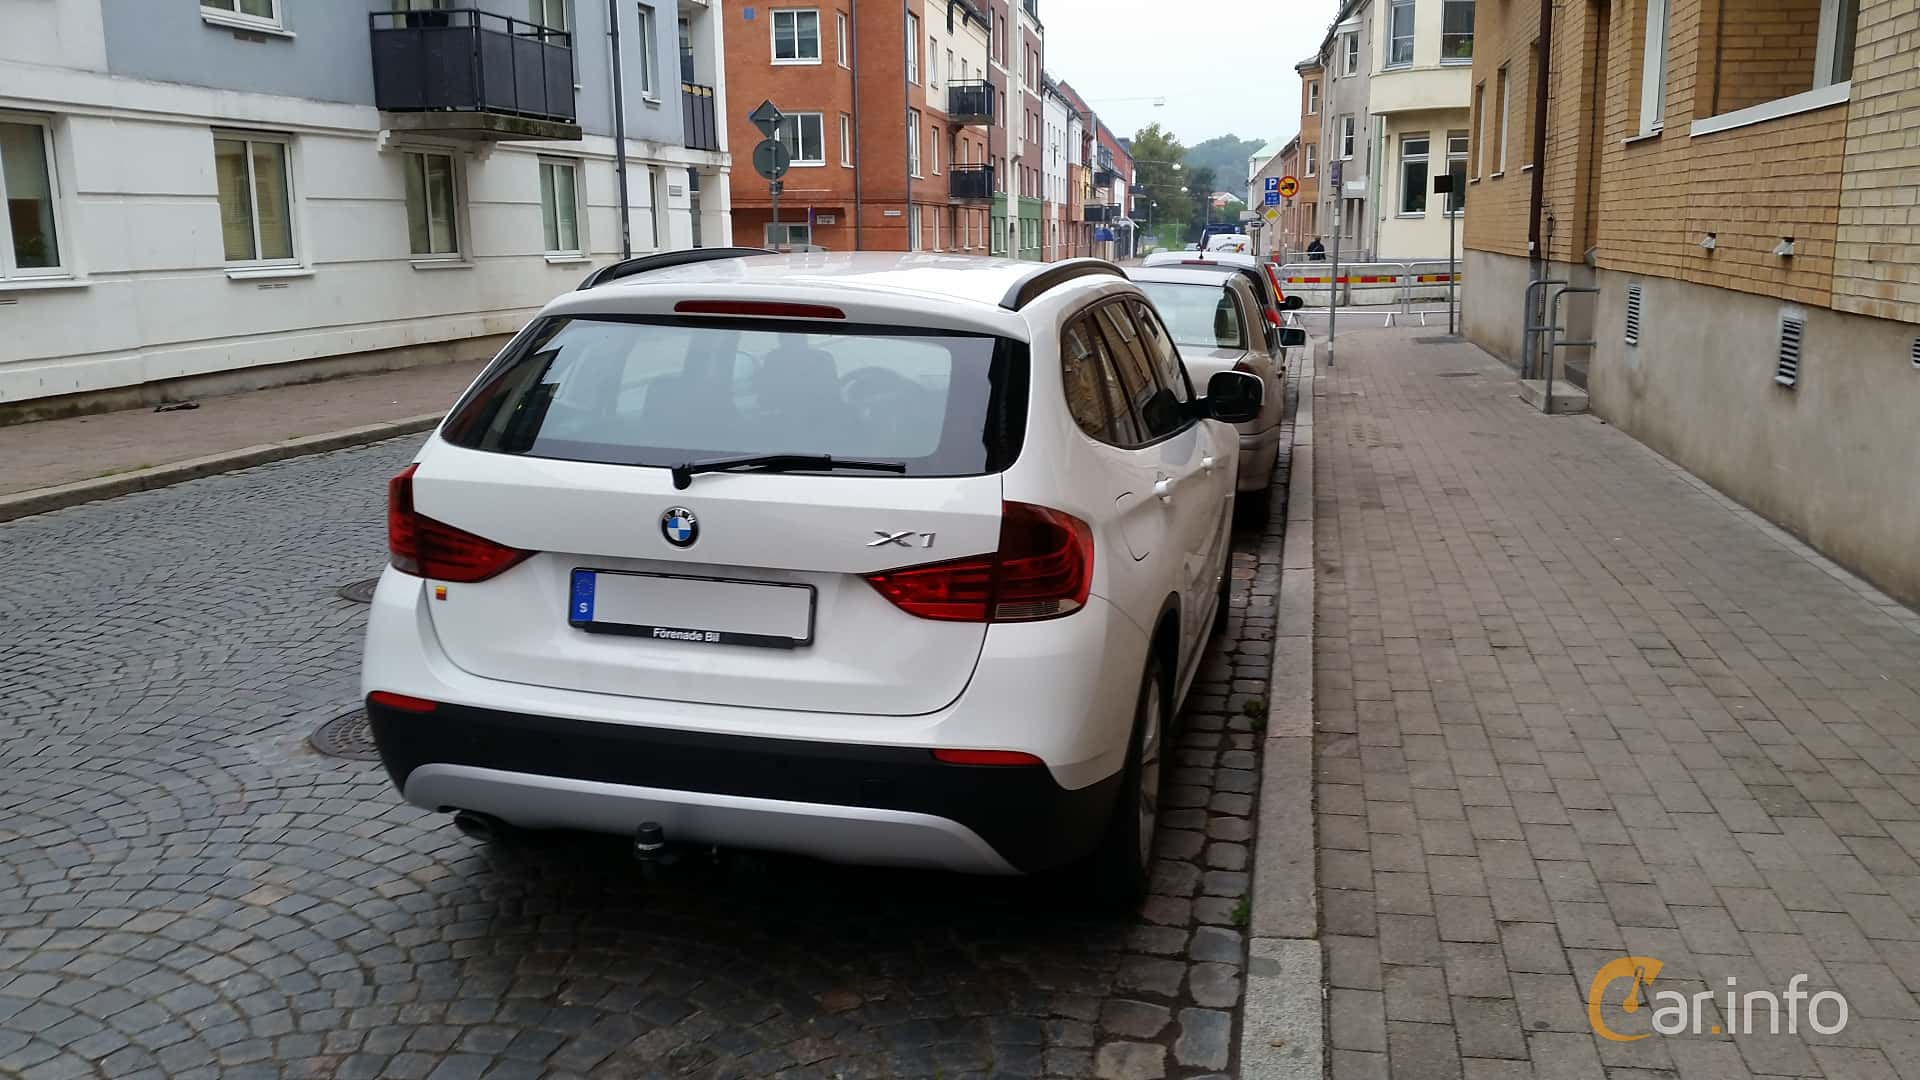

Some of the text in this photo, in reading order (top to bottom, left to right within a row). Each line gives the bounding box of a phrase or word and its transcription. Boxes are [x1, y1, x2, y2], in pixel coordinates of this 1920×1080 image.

[1269, 178, 1277, 190] P
[865, 531, 937, 548] X1
[579, 602, 588, 613] S
[653, 627, 704, 641] Förenade
